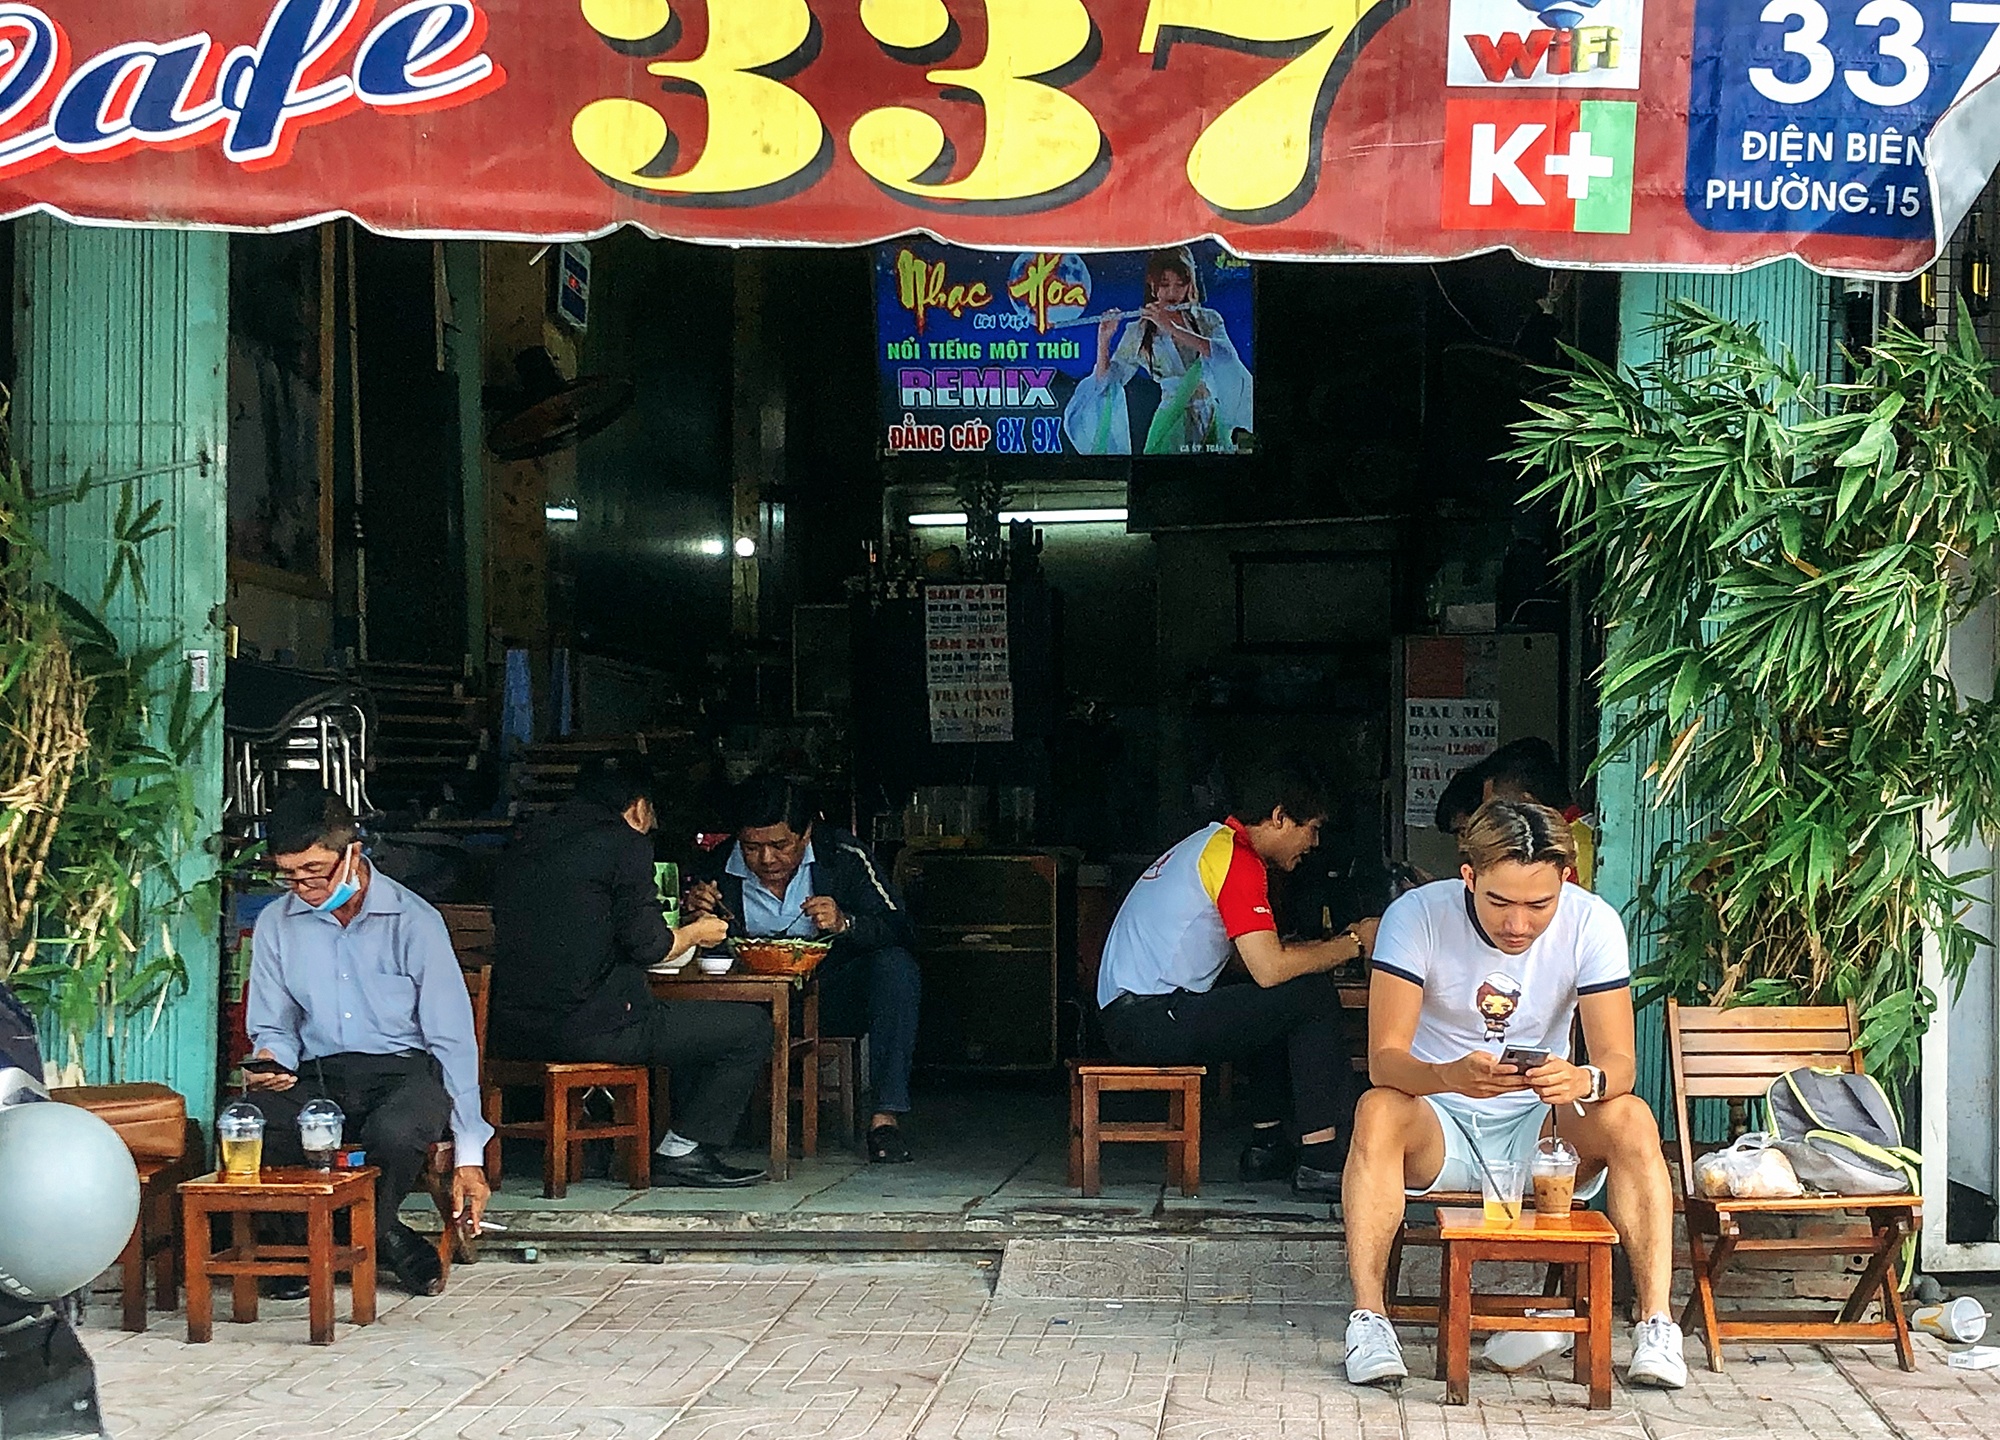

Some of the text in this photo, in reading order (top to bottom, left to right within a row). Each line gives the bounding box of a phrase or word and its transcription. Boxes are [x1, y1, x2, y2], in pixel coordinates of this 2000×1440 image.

[572, 0, 1388, 214] 337
[1468, 123, 1613, 206] K+
[1742, 124, 1928, 168] ĐIỆN BIÊN
[897, 248, 1088, 334] Nhạc Hoa
[887, 336, 1080, 361] NỔI TIẾNG MỘT THỜI
[899, 368, 1057, 408] REMIX
[949, 418, 991, 451] CẤP
[997, 417, 1026, 453] 8X
[1033, 417, 1063, 453] 9X
